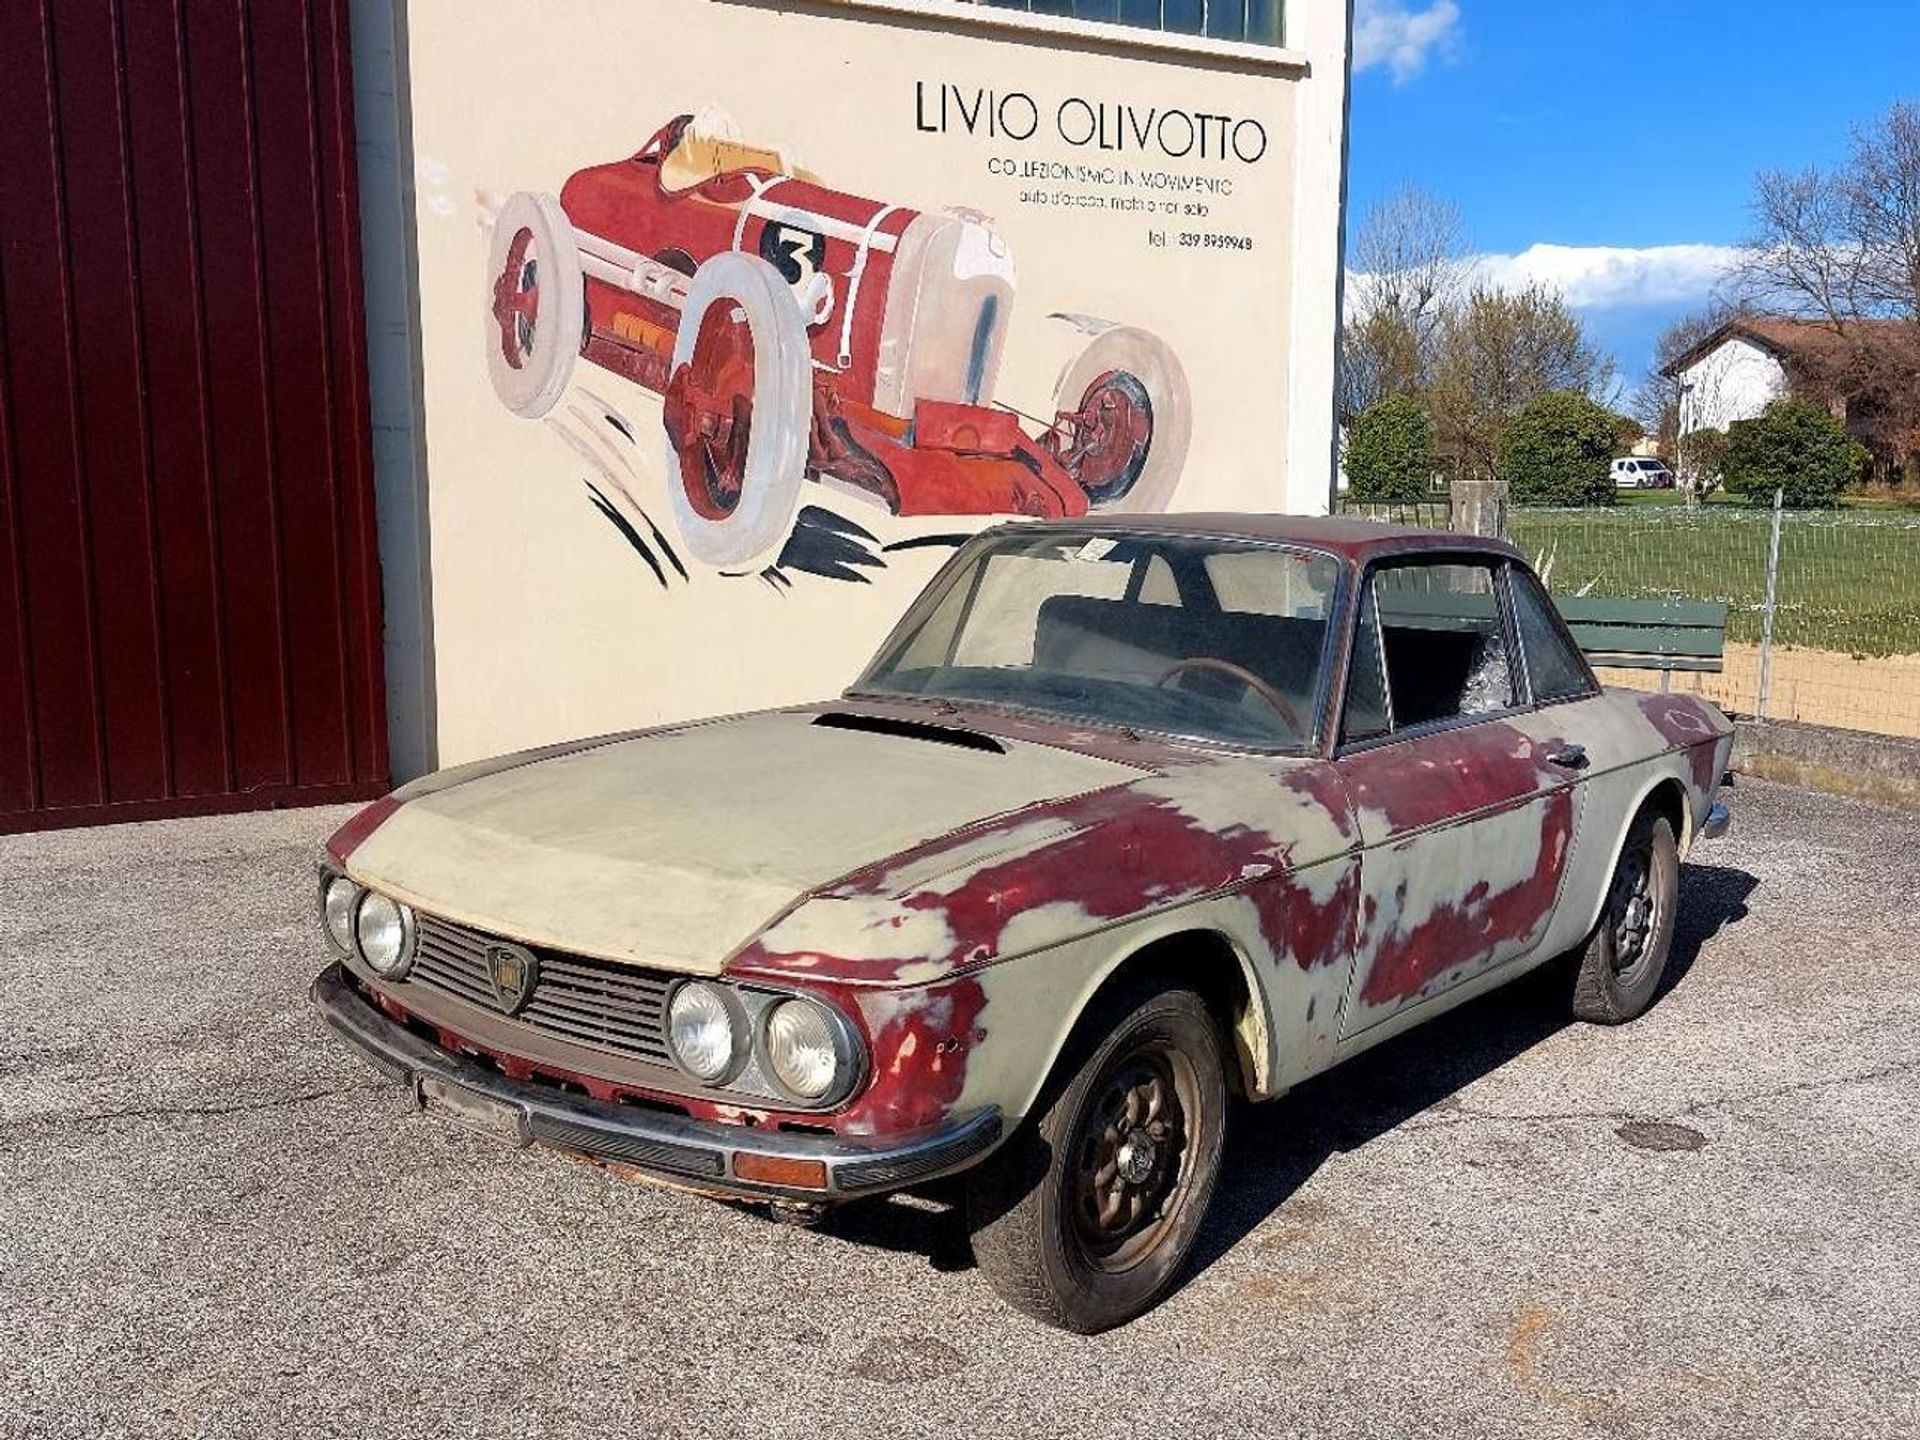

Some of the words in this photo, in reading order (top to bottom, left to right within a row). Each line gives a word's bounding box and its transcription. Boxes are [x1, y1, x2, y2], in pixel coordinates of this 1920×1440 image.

[916, 81, 1038, 140] LIVIO
[1057, 97, 1267, 163] OLIVOTTO
[778, 227, 814, 287] 3
[1179, 232, 1201, 248] 339
